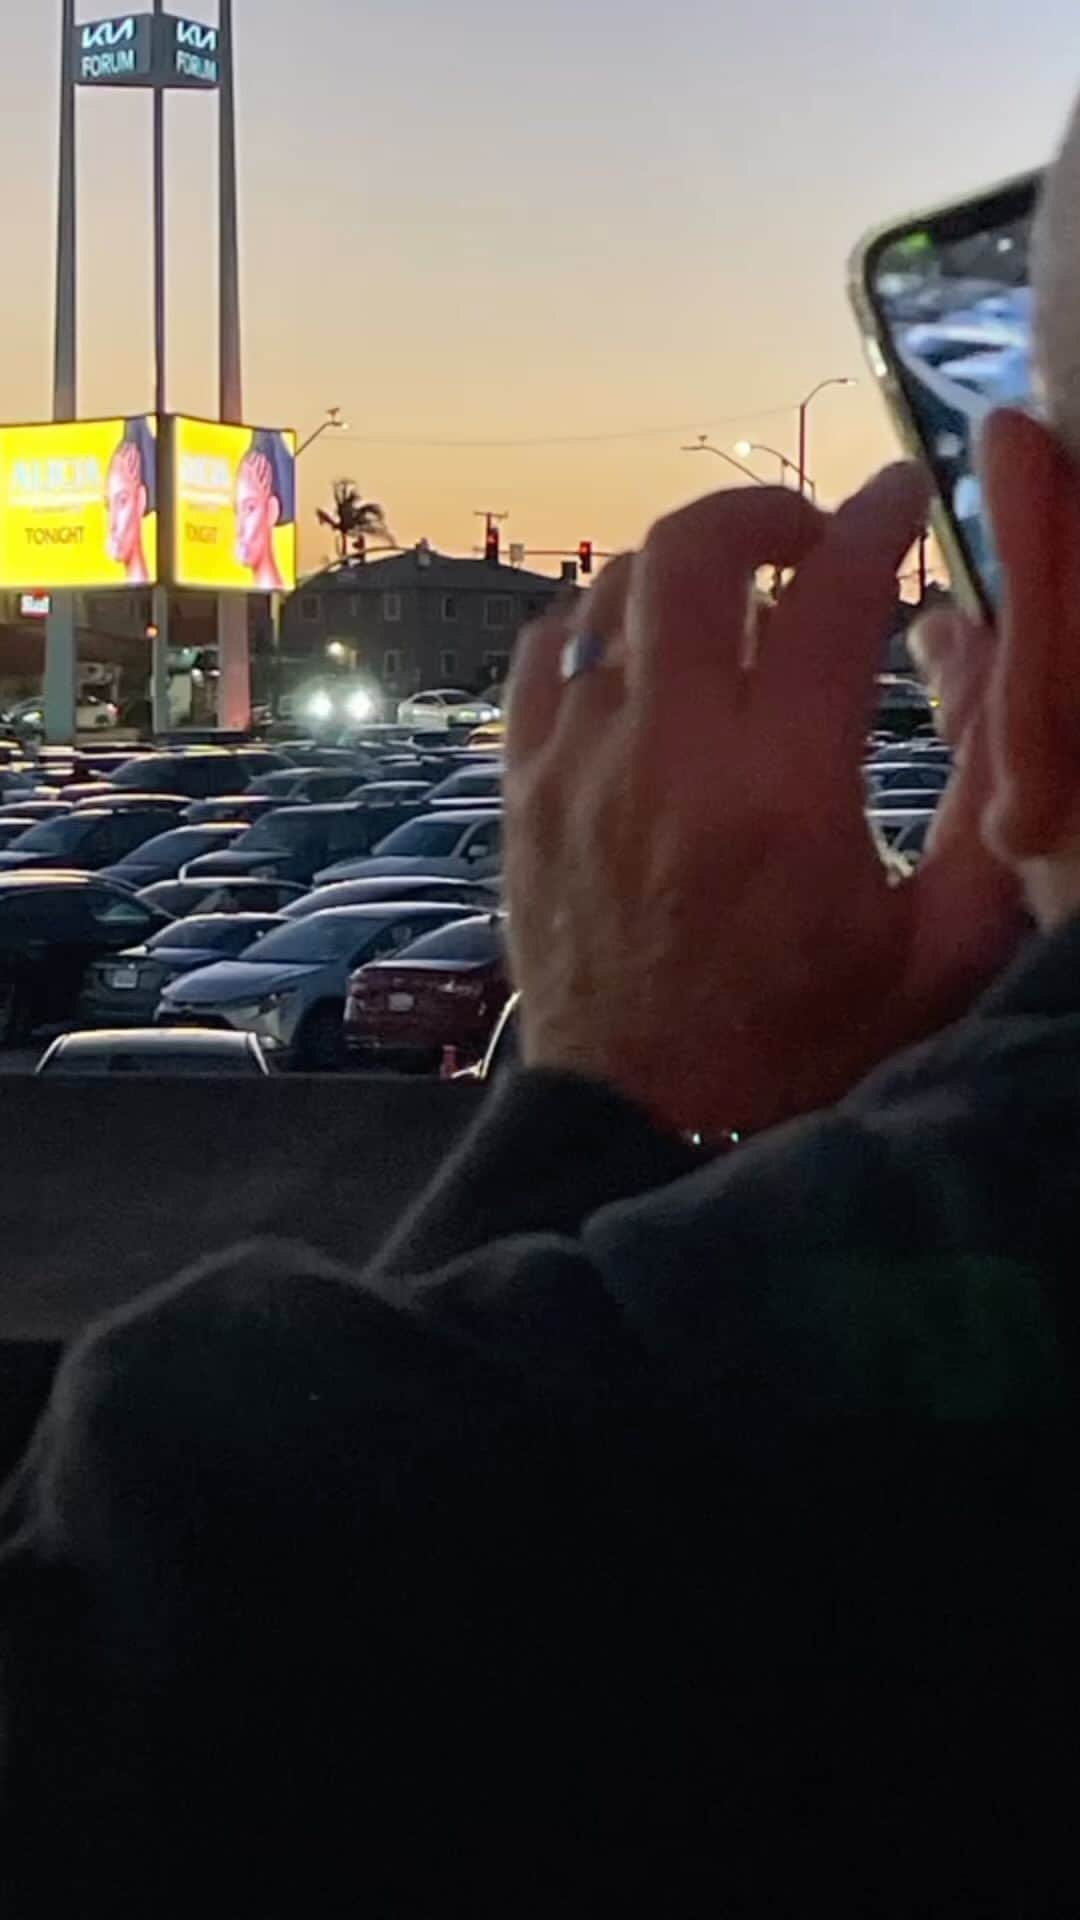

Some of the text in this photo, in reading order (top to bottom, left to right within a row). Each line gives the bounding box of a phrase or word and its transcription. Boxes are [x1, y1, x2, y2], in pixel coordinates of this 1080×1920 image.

[82, 49, 135, 77] FORUM
[176, 50, 216, 82] FORUM
[24, 526, 85, 545] TONIGHT
